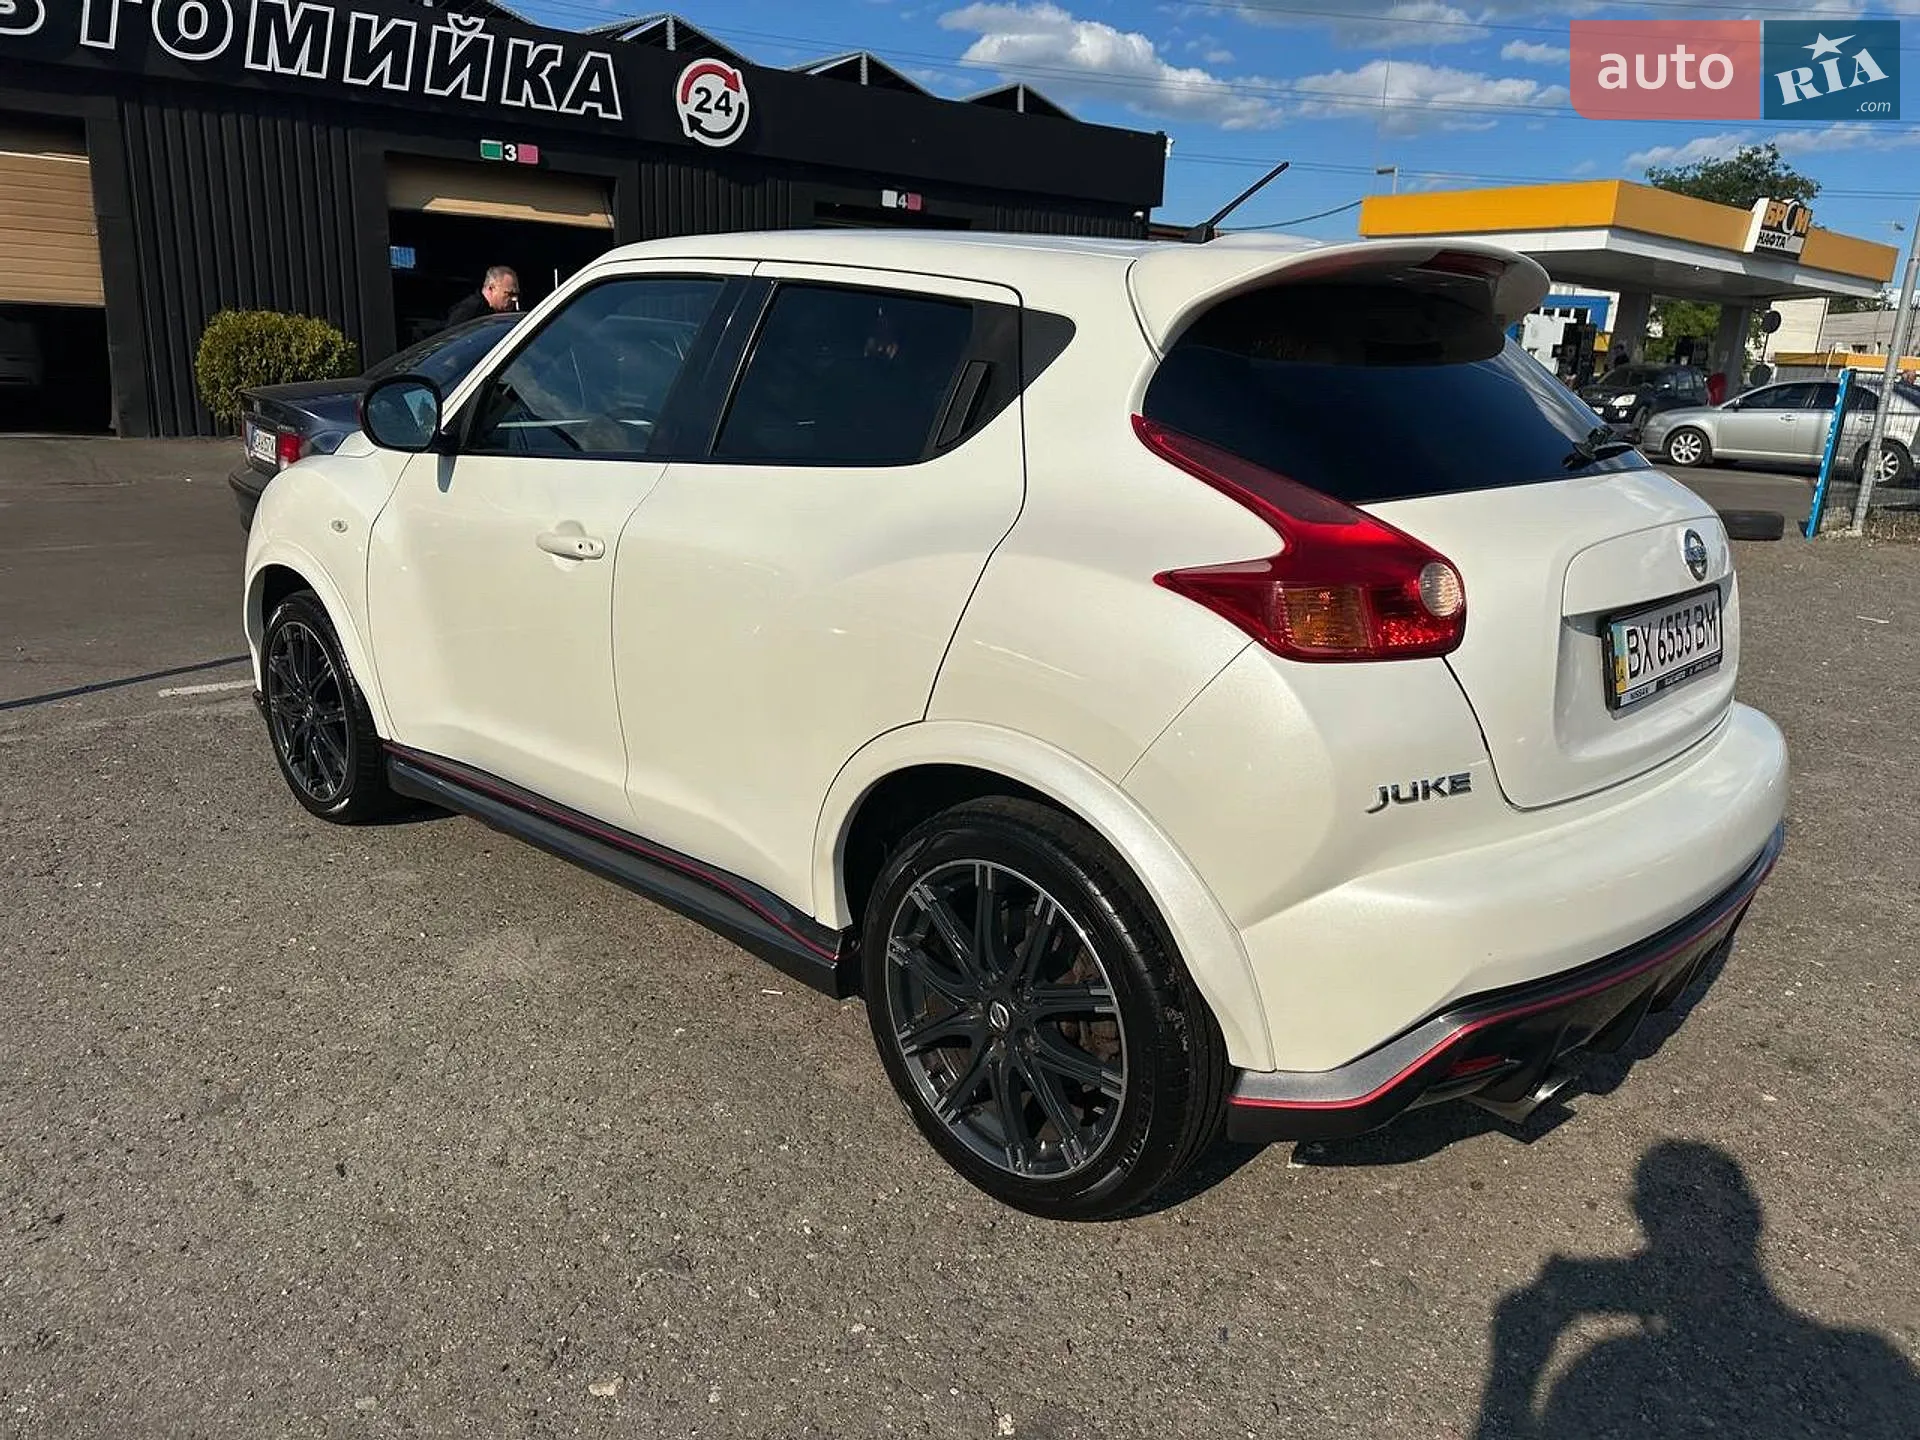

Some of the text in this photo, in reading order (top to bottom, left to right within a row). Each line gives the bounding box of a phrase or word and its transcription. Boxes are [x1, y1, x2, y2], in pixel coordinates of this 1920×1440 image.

[694, 86, 733, 117] 24
[504, 144, 517, 161] 3
[898, 193, 908, 209] 4
[1627, 622, 1654, 679] BX
[1657, 609, 1692, 667] 6553
[1694, 601, 1717, 651] BM
[1364, 772, 1472, 814] JUKE
